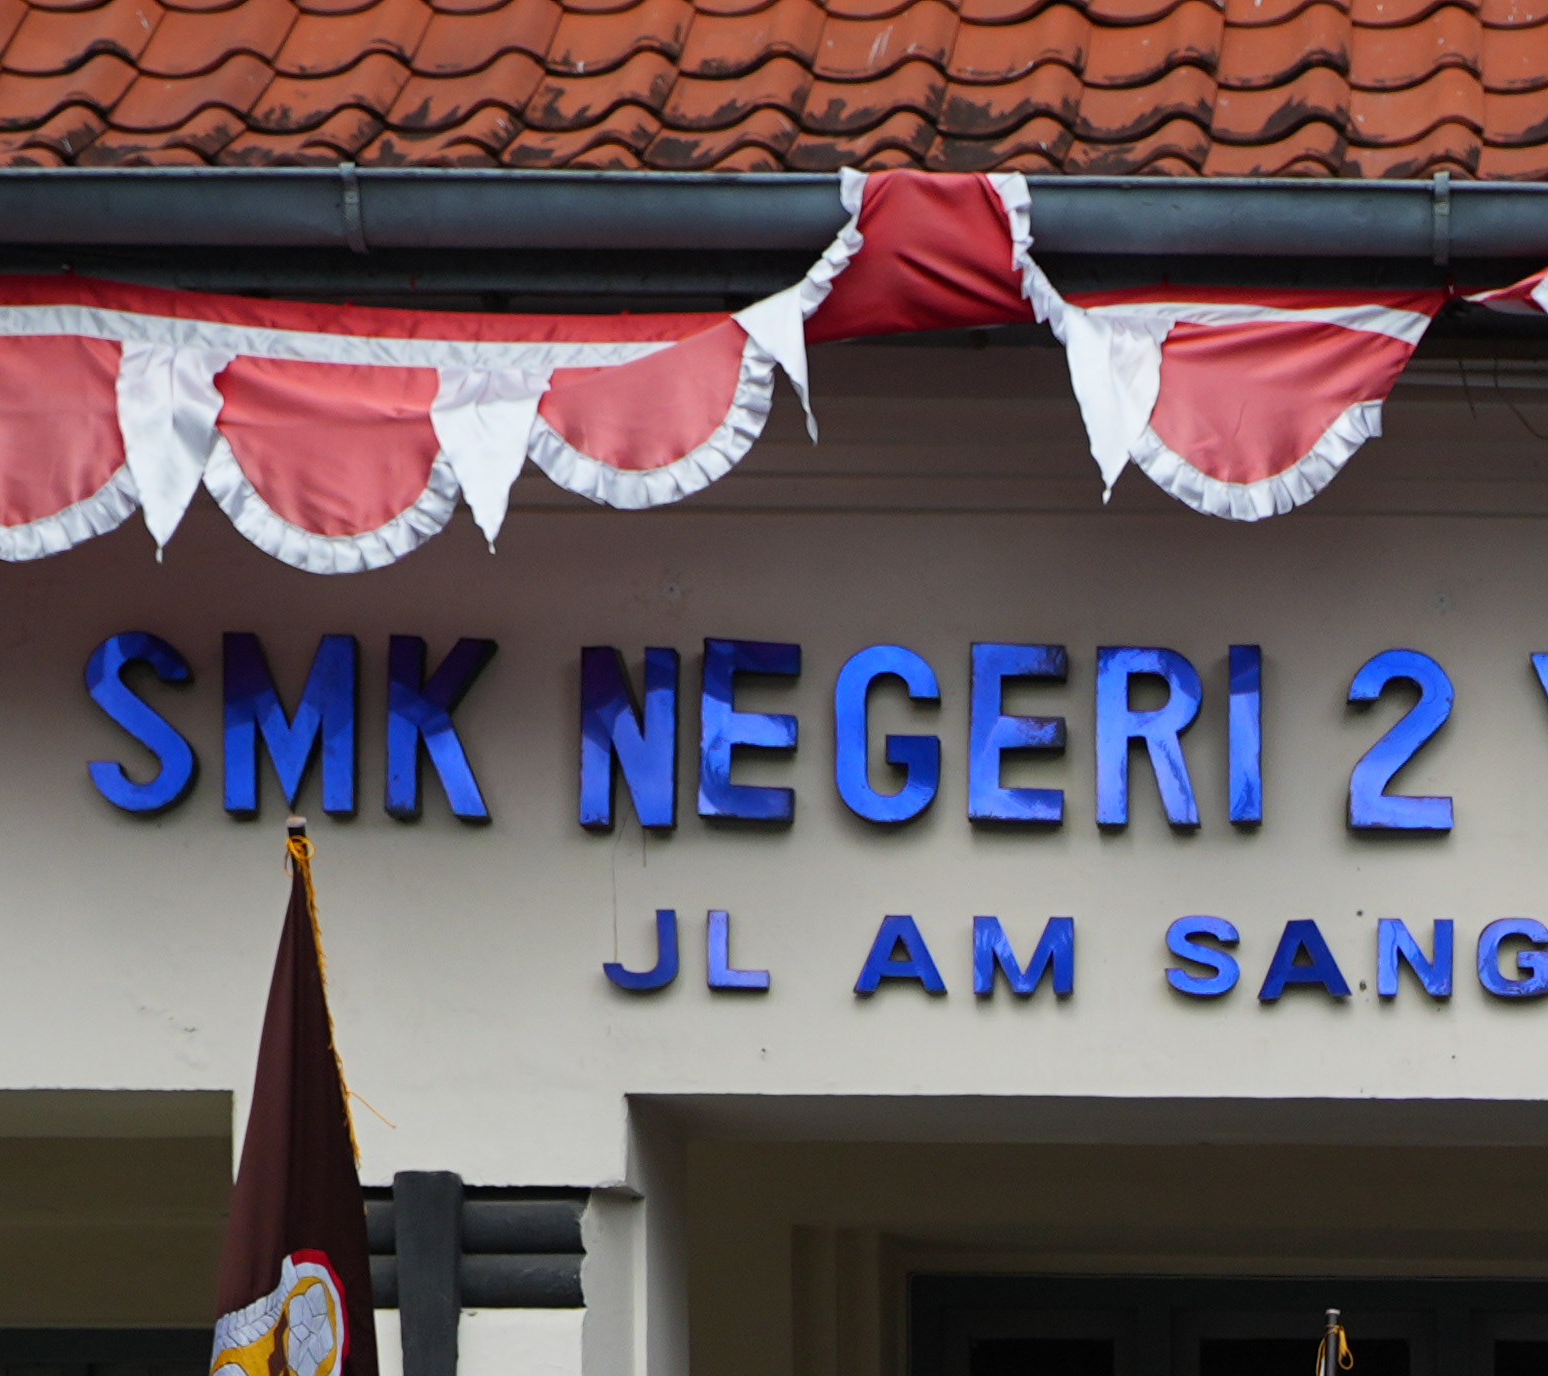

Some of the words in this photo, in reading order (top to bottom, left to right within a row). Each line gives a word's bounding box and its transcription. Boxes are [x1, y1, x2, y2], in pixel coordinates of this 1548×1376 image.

[84, 629, 498, 824] SMK
[578, 636, 1263, 832] NEGERI
[1346, 646, 1454, 832] 2
[603, 907, 771, 993] JL
[853, 913, 1076, 997] AM
